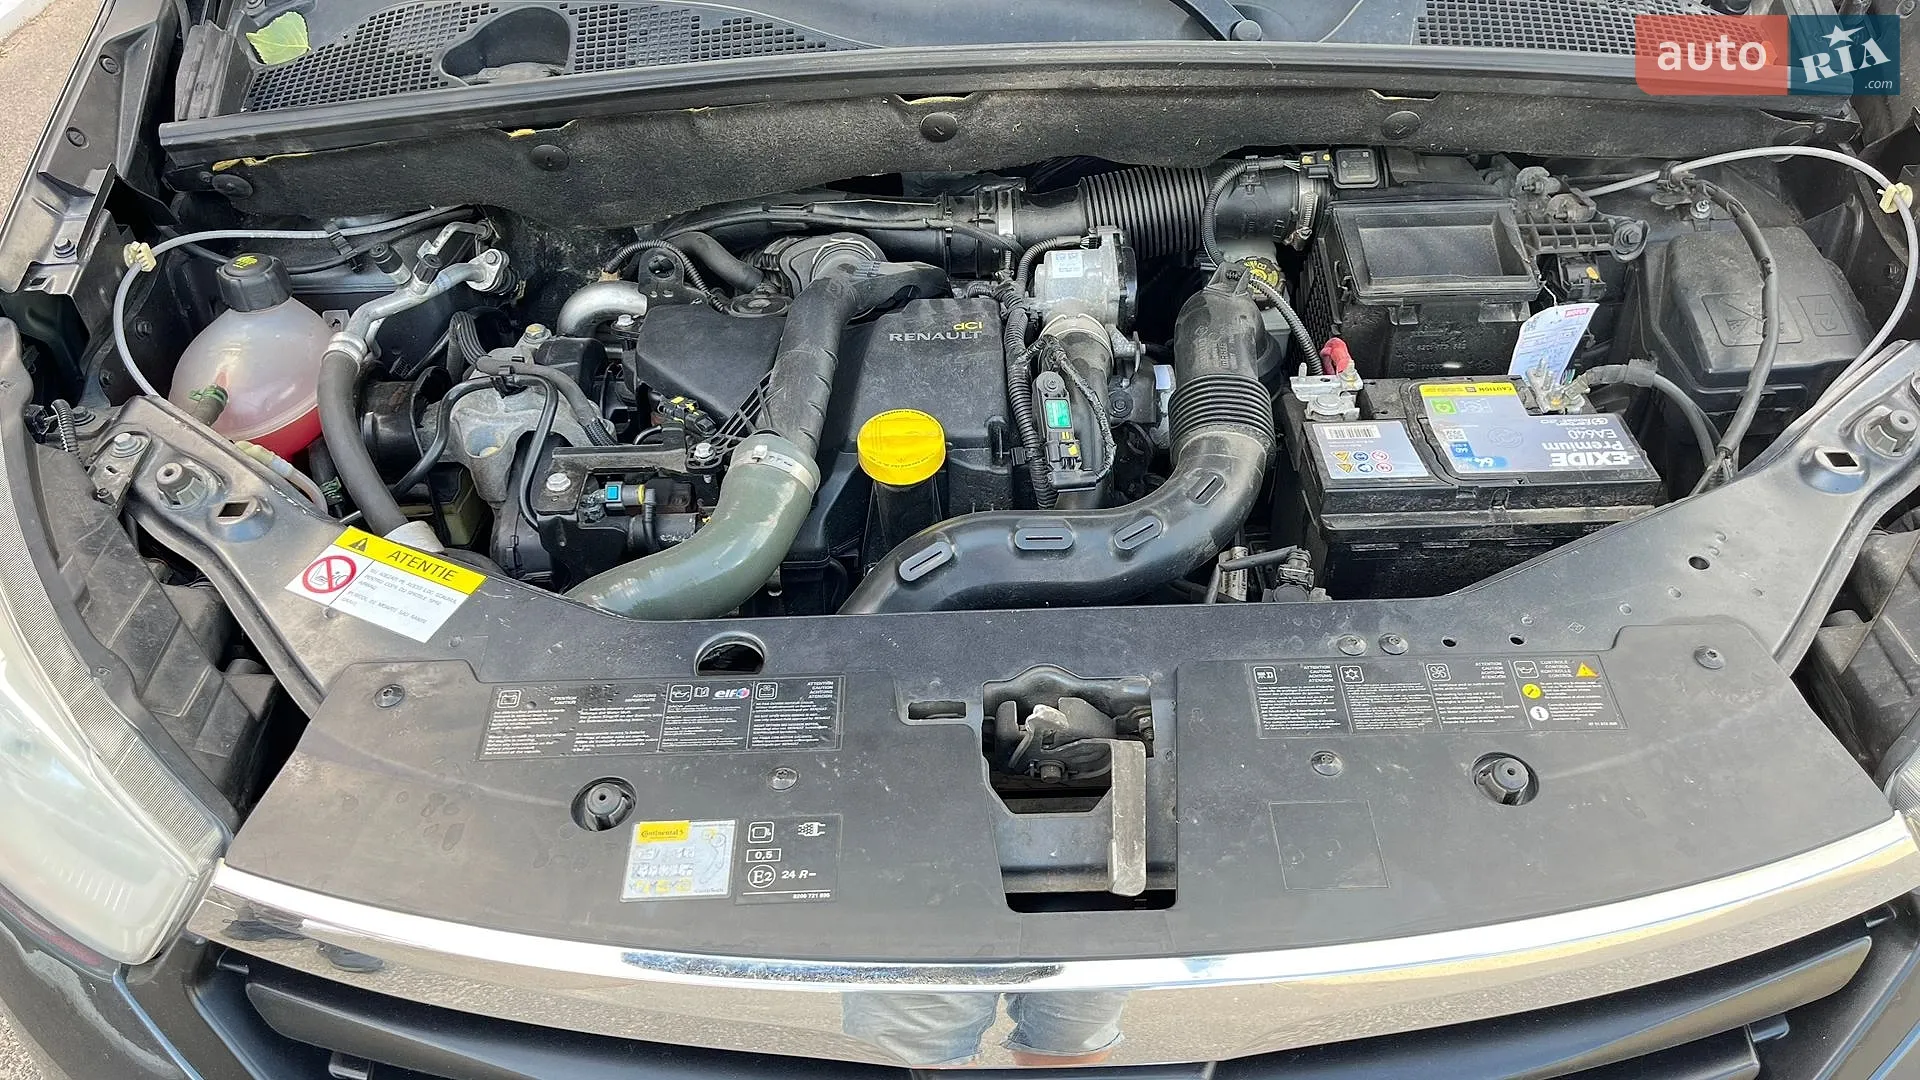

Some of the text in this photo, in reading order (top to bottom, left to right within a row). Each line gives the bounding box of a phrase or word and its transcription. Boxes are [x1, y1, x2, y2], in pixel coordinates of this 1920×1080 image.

[889, 331, 983, 342] RENAULT
[1567, 429, 1617, 440] EA640
[1541, 440, 1625, 451] Premium
[1549, 451, 1634, 467] EXIDE
[387, 550, 459, 582] ATENTIE
[714, 688, 737, 698] elf
[640, 829, 680, 838] Continental
[754, 851, 773, 861] 0,5
[753, 871, 772, 884] E2
[781, 870, 796, 879] 24
